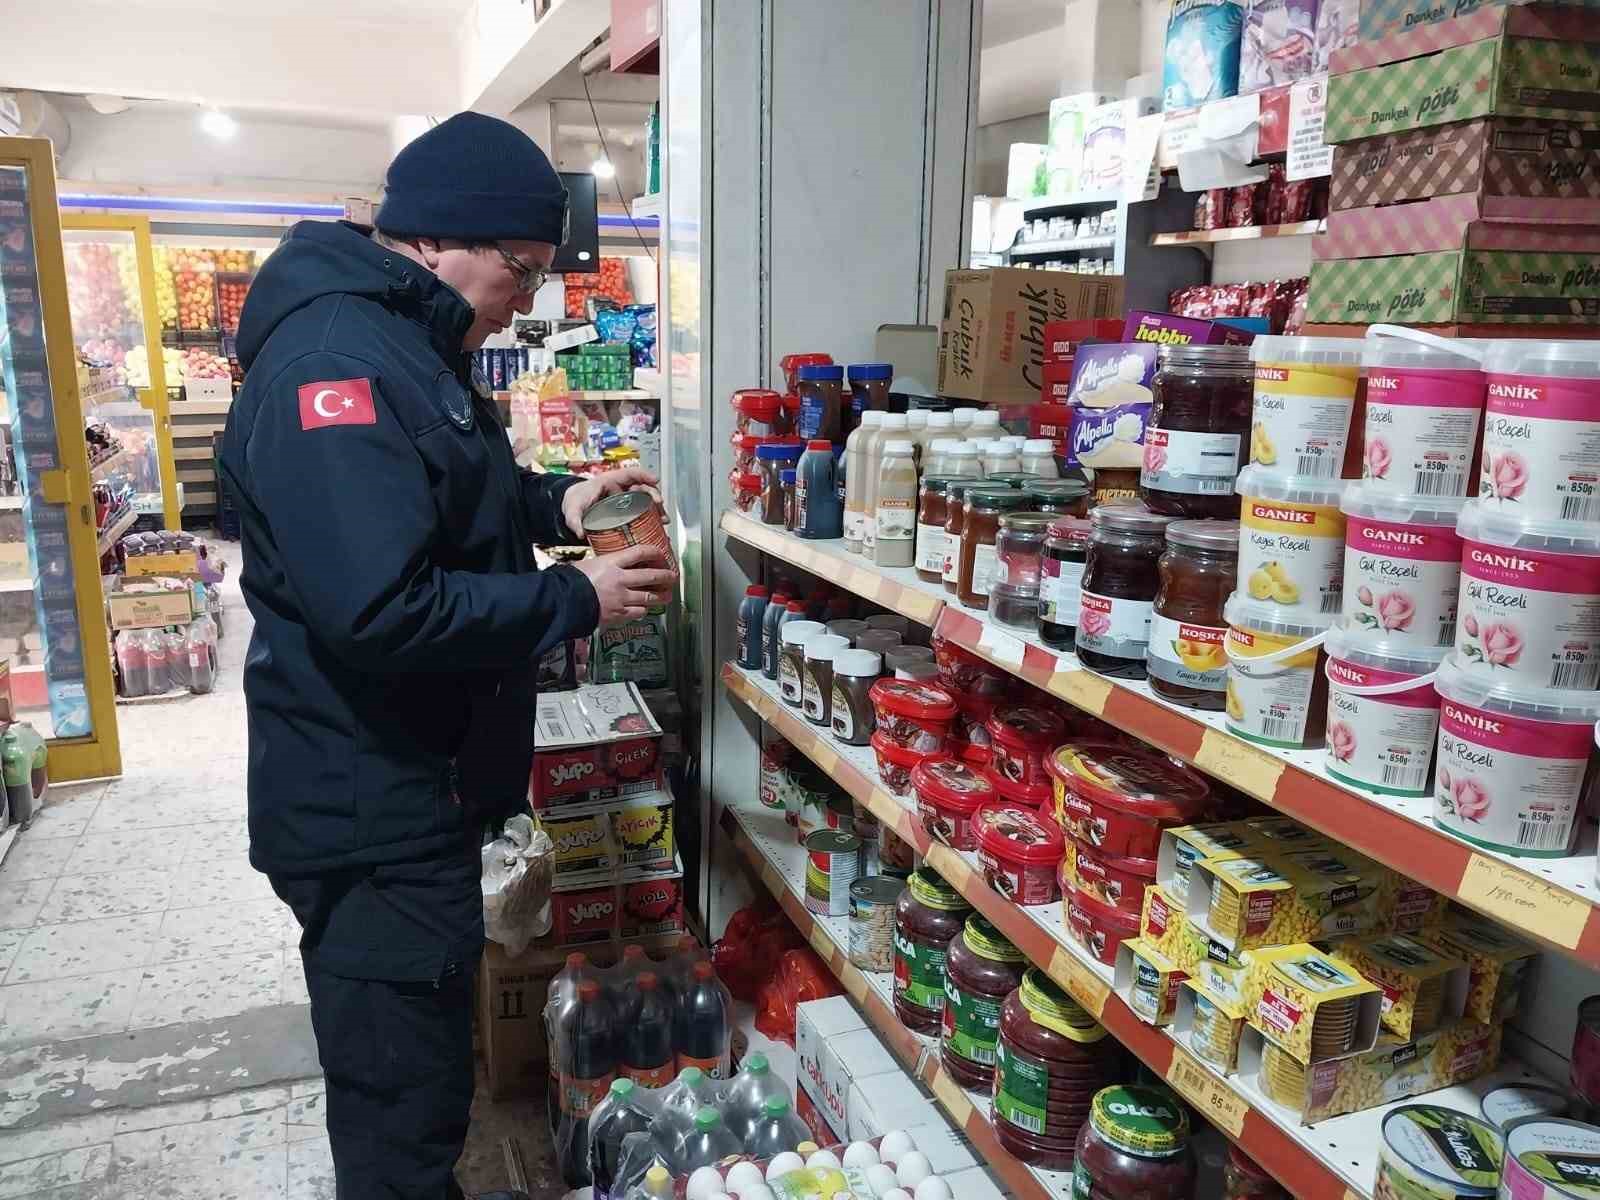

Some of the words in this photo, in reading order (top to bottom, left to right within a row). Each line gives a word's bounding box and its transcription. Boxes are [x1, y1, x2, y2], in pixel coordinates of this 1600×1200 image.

[1371, 106, 1409, 124] Dankek
[1416, 82, 1461, 121] pöti
[1347, 300, 1382, 313] Dankek
[1387, 287, 1427, 317] pöti
[1135, 324, 1193, 344] hobby
[1076, 356, 1120, 390] Alpella
[1255, 368, 1284, 381] ANİK
[1368, 375, 1400, 389] ANİK
[1489, 384, 1539, 400] GANİK
[1074, 421, 1114, 452] Alpella
[1497, 419, 1531, 439] Reçeli
[1426, 461, 1446, 472] 850g
[1570, 483, 1593, 495] 850g
[1254, 507, 1309, 522] GANİK
[1279, 536, 1312, 551] Reçeli
[1362, 527, 1425, 546] GANİK
[1380, 560, 1420, 579] Reçeli
[1471, 550, 1536, 573] GANİK
[1485, 586, 1527, 609] Reçeli
[1565, 650, 1585, 662] 850g
[1333, 664, 1365, 683] ANİK
[1445, 705, 1502, 734] GANİK
[1456, 743, 1495, 769] Reçeli
[550, 761, 594, 786] Yupo
[1531, 811, 1551, 823] 850g
[568, 901, 613, 924] Yupo
[895, 932, 917, 959] LCA
[1108, 1102, 1174, 1119] OLCA
